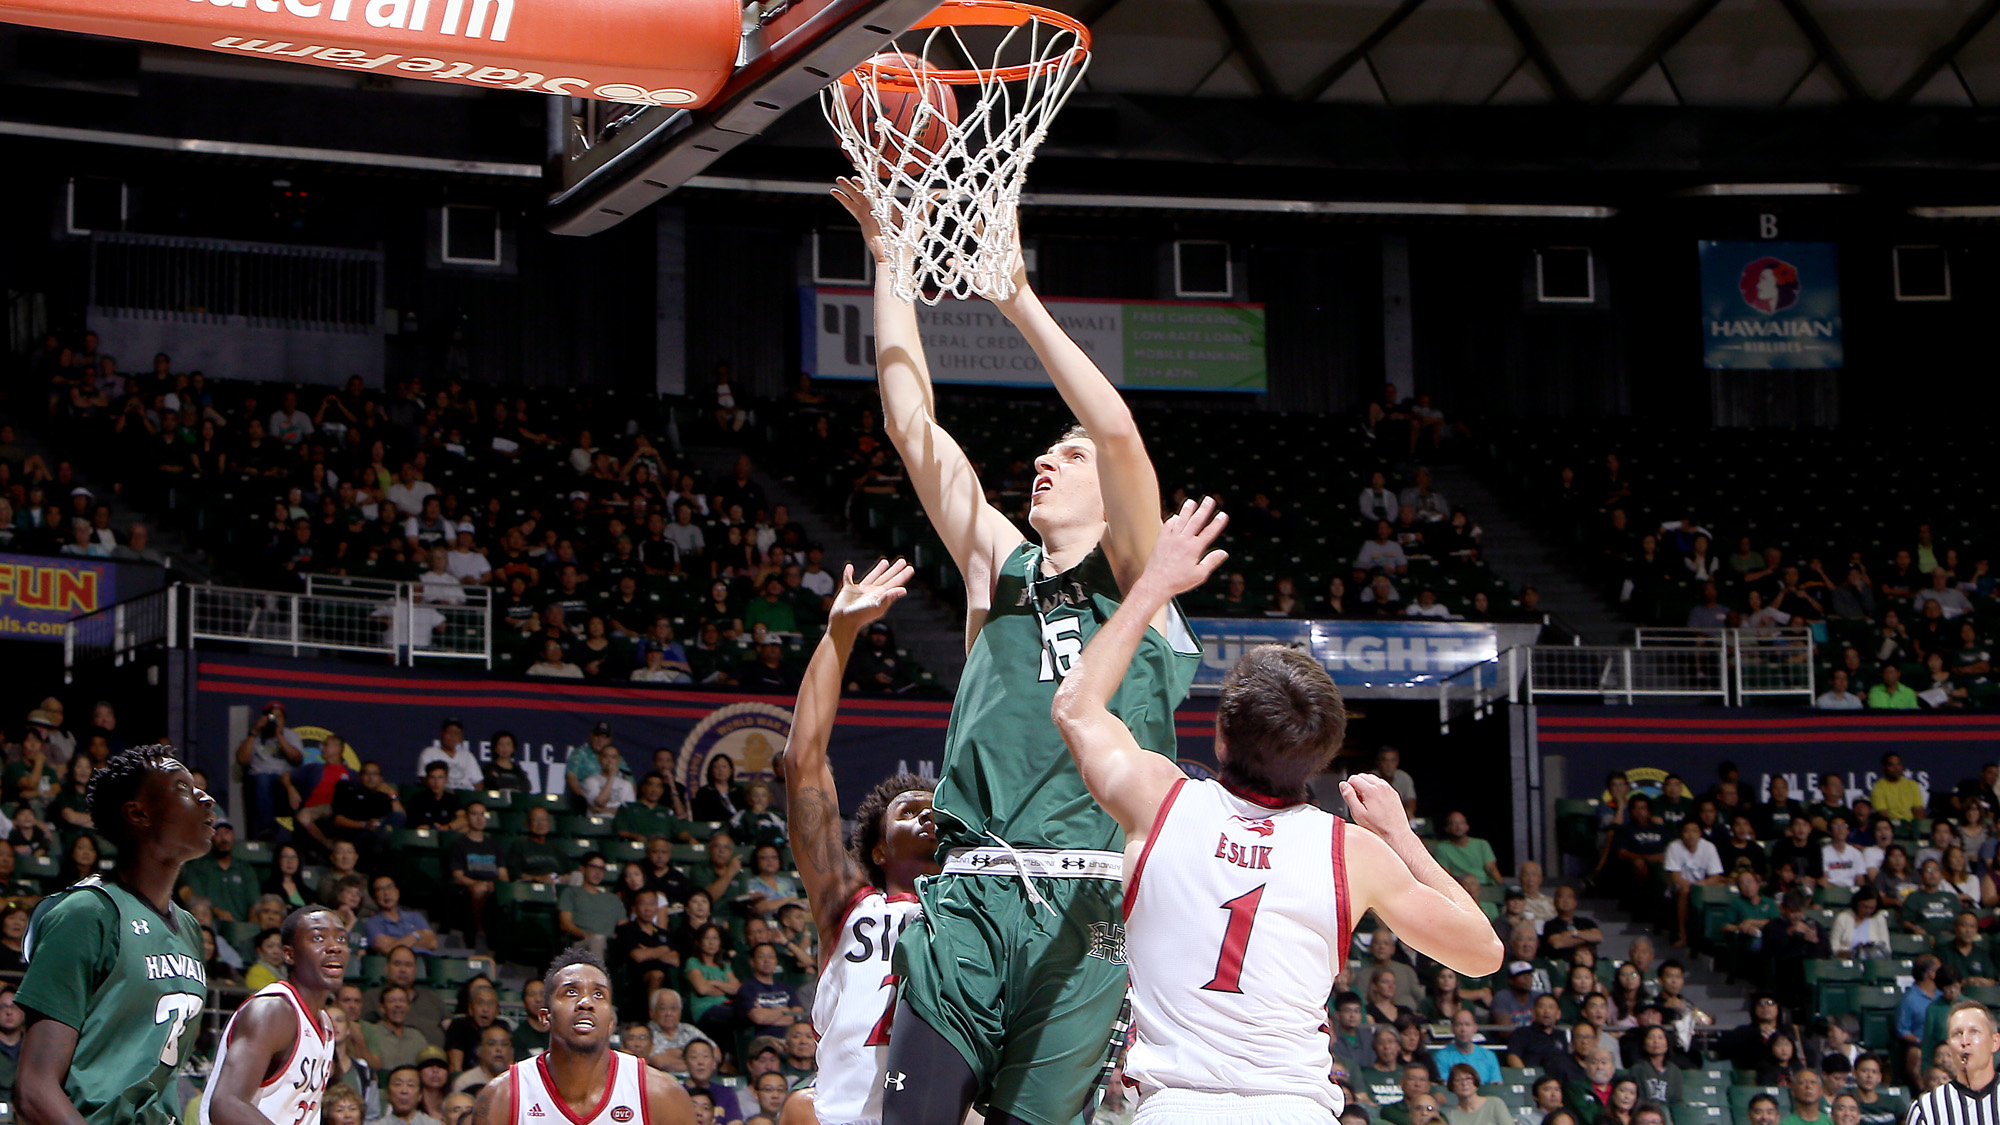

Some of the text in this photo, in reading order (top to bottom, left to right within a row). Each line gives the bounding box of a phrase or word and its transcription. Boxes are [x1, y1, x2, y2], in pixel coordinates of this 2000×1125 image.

[211, 36, 590, 96] StateFarm
[1760, 213, 1779, 239] B
[916, 311, 996, 328] VERSITY
[1132, 312, 1240, 326] FREE CHECKING
[1711, 320, 1833, 337] HAWAIIAN
[975, 336, 1030, 350] CREDI
[939, 354, 1041, 371] UHFCU.CO
[1134, 349, 1250, 362] MOBILE BANKING
[0, 615, 78, 637] ls.com
[716, 716, 754, 735] WORLD
[1214, 832, 1273, 870] ESLIK
[1199, 882, 1267, 995] 1
